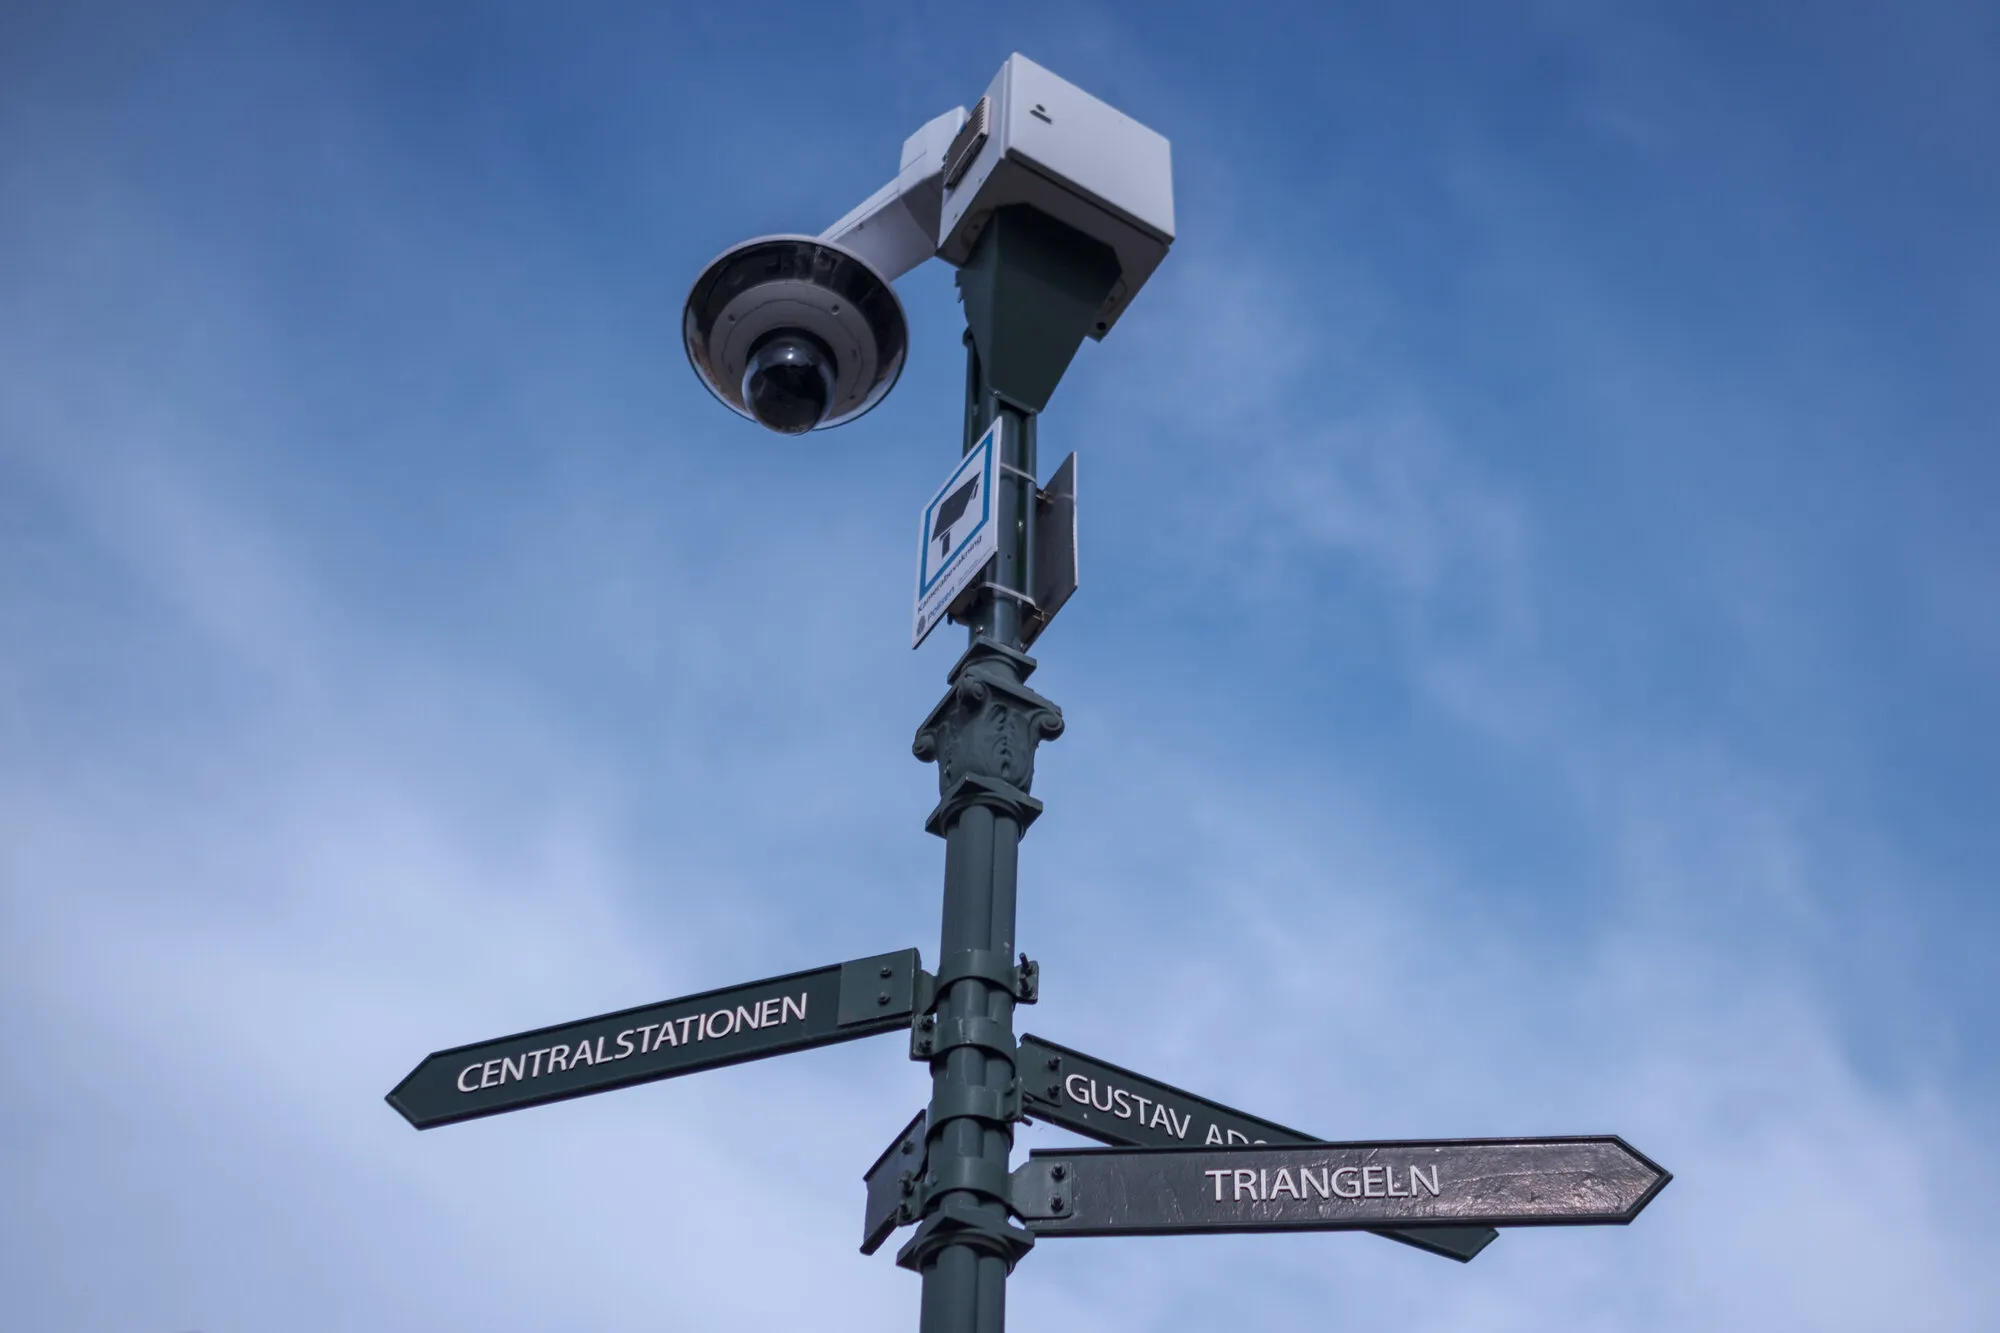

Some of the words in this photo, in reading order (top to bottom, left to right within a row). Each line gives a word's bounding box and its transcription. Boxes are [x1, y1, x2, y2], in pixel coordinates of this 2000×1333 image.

[457, 992, 808, 1094] CENTRALSTATIONEN
[1064, 1073, 1191, 1139] GUSTAV
[1205, 1124, 1267, 1145] AD
[1204, 1165, 1440, 1202] TRIANGELN
